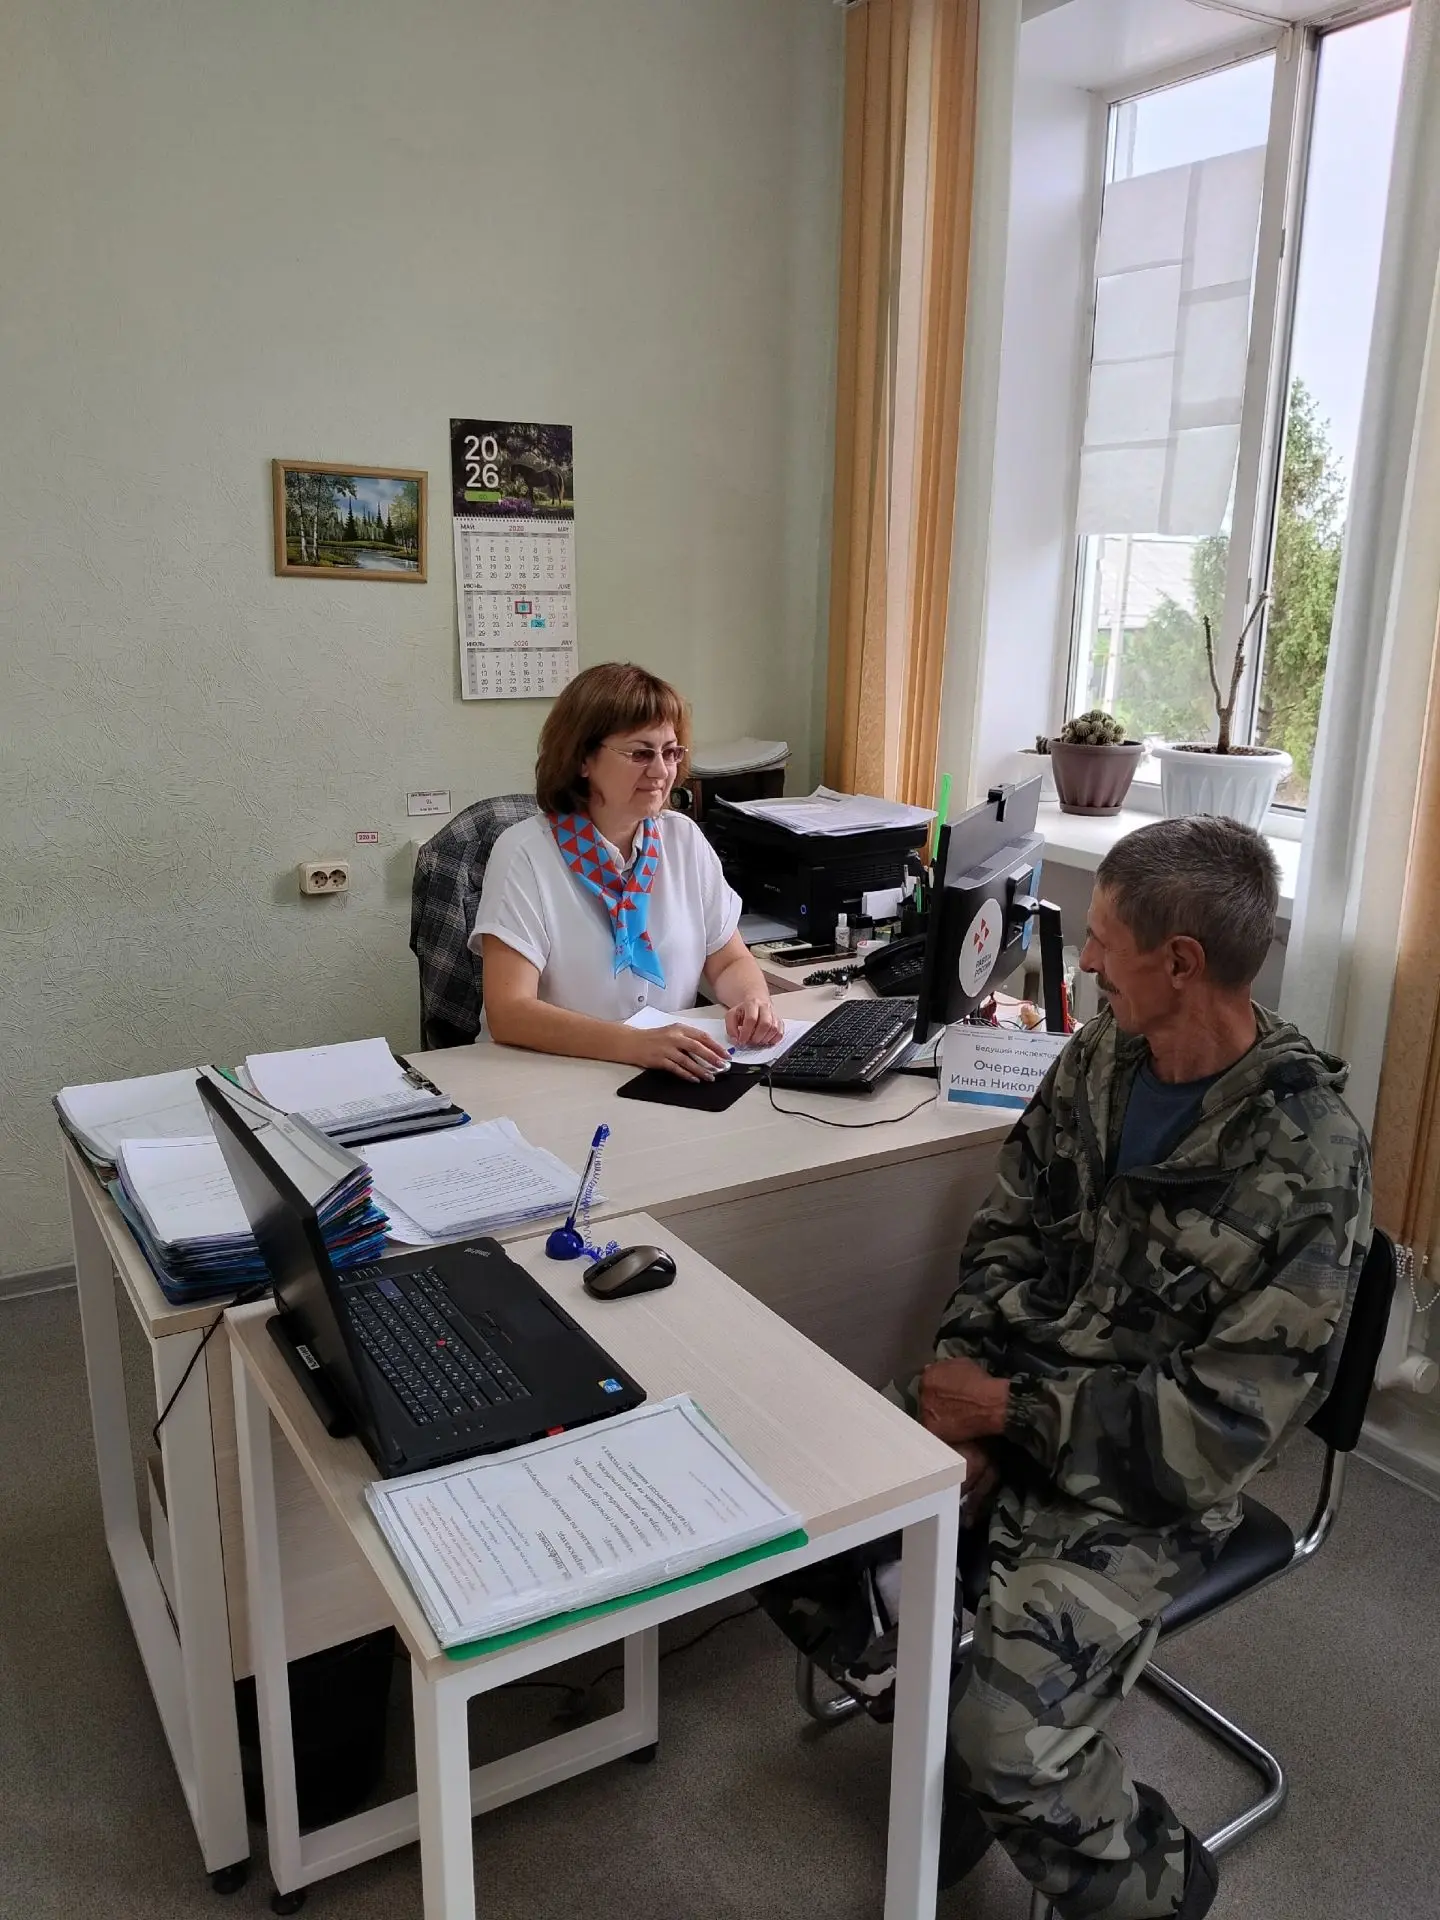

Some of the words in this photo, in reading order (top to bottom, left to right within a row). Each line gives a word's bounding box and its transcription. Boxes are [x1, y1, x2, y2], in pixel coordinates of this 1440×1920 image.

[464, 435, 498, 461] 20
[465, 463, 499, 488] 26
[975, 1044, 1013, 1055] Ведущий
[1014, 1049, 1057, 1059] инспектор
[974, 1060, 1048, 1077] Очередьк
[951, 1074, 986, 1087] Инна
